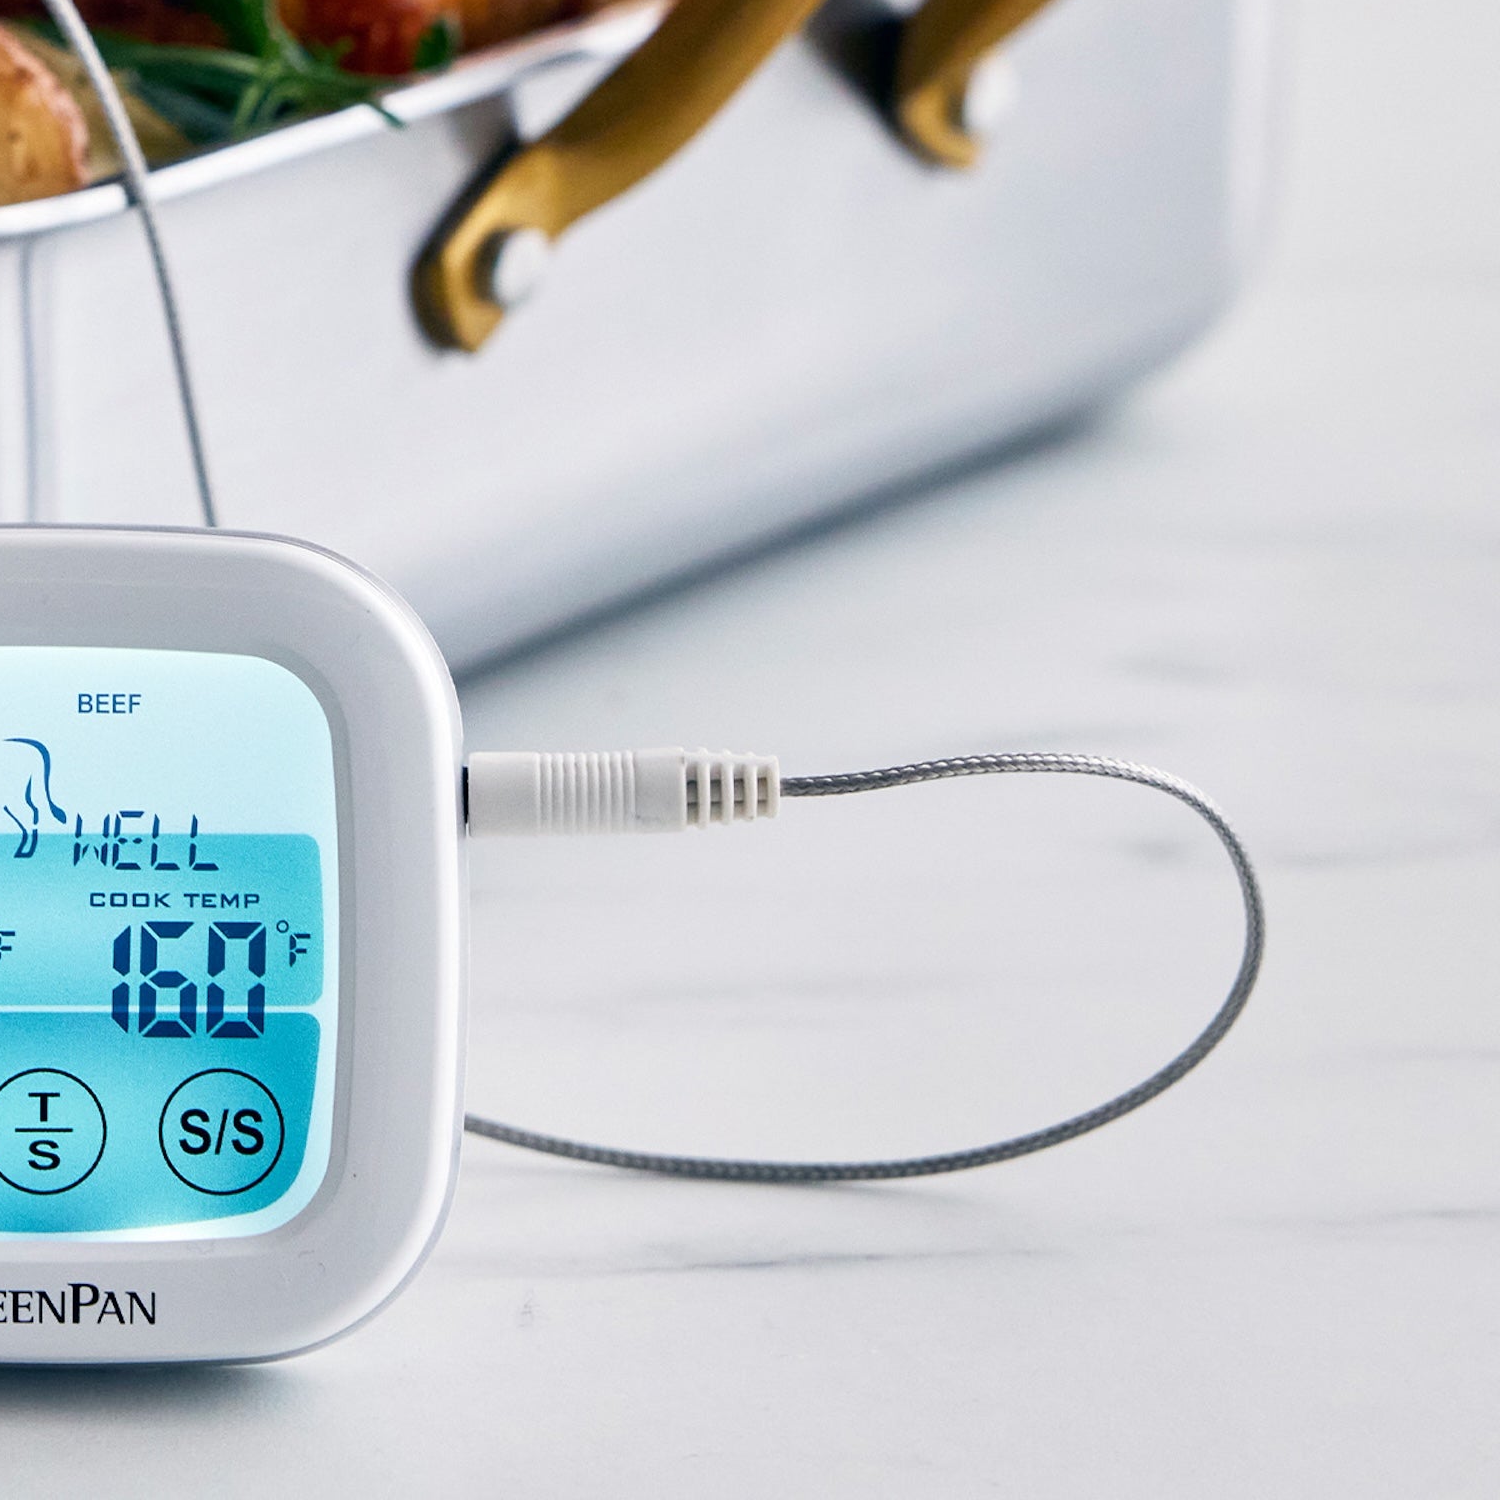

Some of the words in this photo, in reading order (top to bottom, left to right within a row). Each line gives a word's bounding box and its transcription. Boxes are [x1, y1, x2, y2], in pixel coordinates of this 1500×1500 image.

[77, 693, 142, 714] BEEF
[73, 811, 219, 871] WELL
[89, 893, 171, 908] COOK
[183, 893, 260, 908] TEMP
[28, 1092, 61, 1122] T
[179, 1108, 264, 1156] S/S
[27, 1139, 61, 1171] S
